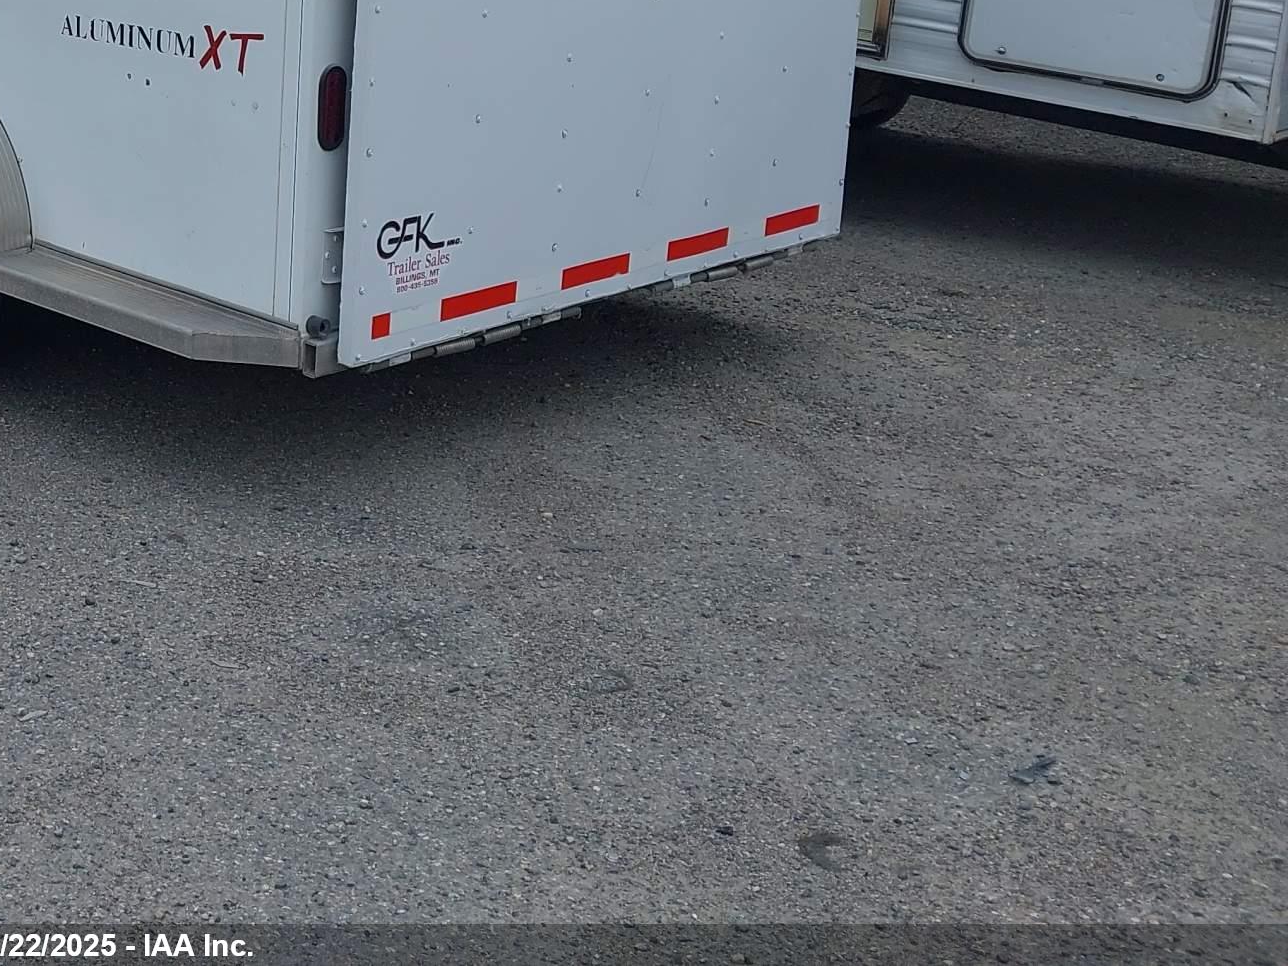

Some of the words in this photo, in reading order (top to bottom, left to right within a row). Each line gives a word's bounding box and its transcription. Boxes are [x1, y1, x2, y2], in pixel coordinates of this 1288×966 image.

[60, 13, 197, 59] ALUMINUM
[198, 24, 265, 76] XT
[376, 212, 445, 260] GFK
[387, 256, 422, 277] Trailer
[425, 250, 450, 268] Sales
[429, 268, 440, 278] MT
